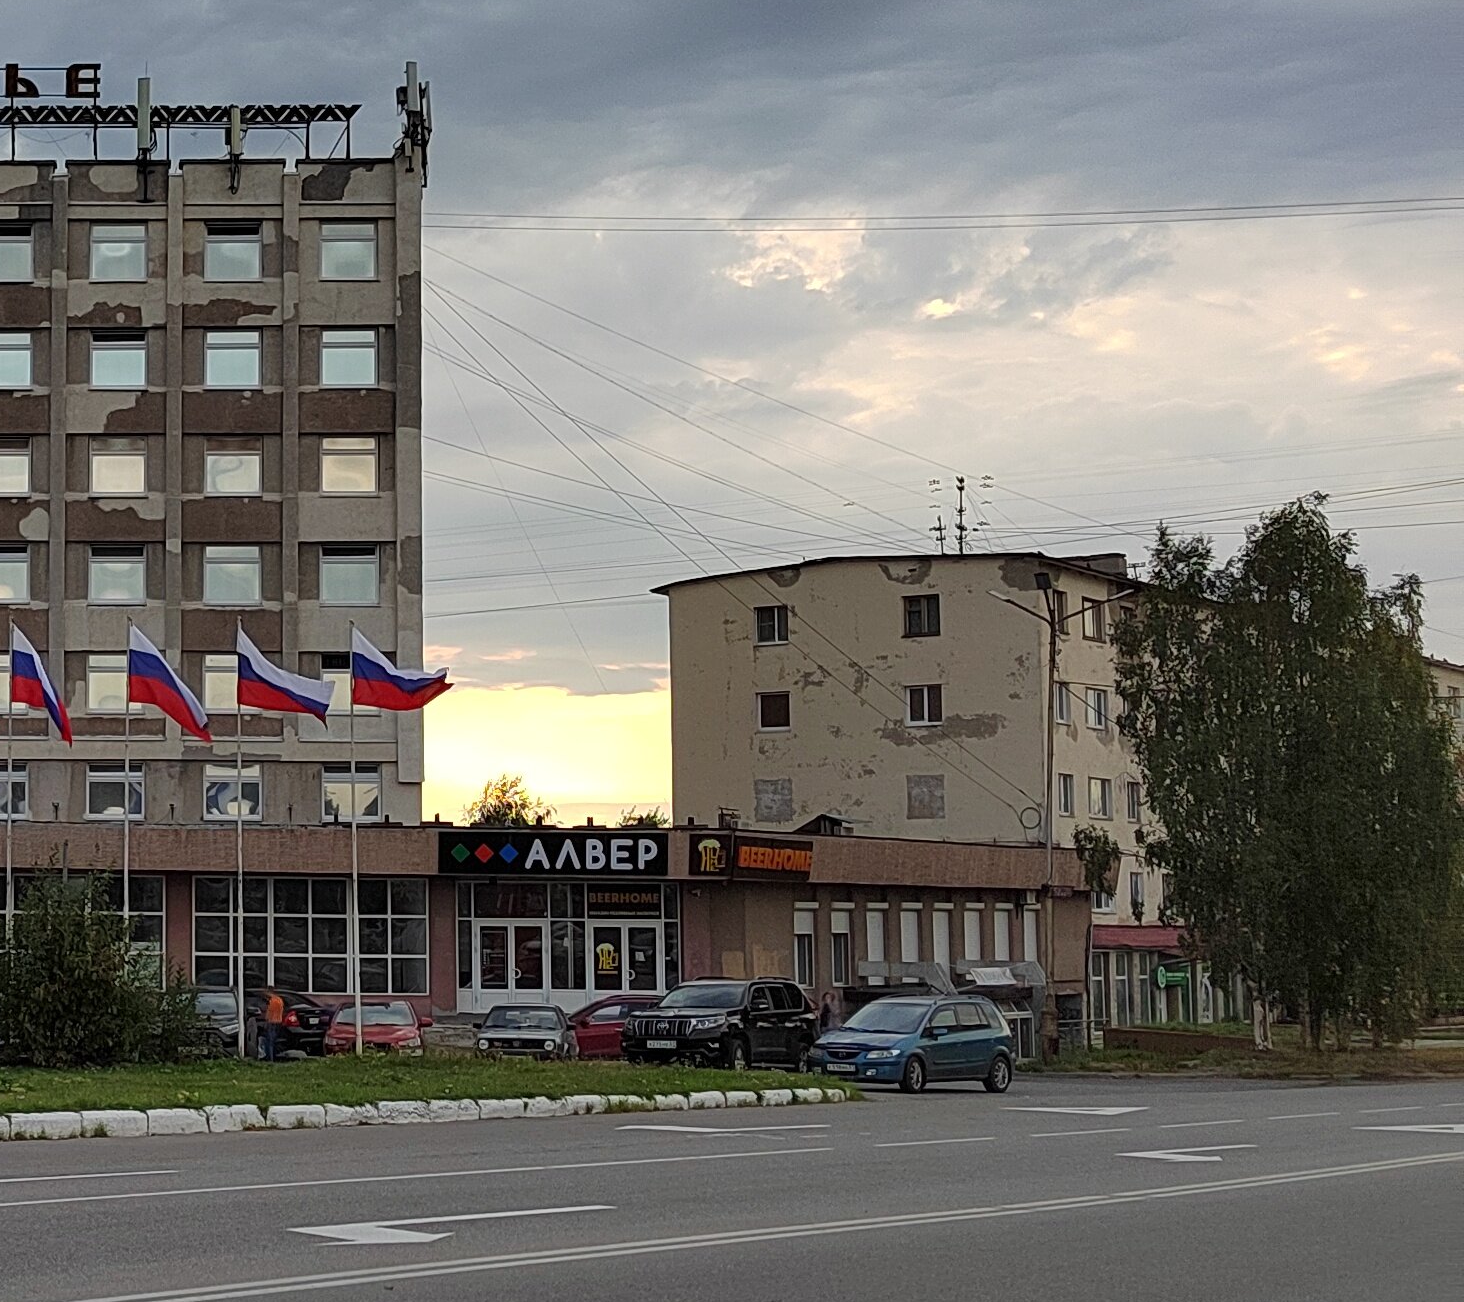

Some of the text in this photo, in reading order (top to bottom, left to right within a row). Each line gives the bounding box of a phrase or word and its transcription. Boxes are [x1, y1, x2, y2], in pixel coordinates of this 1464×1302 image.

[524, 838, 659, 870] АЛВЕР
[737, 844, 813, 872] BEERHOME
[589, 892, 660, 904] BEERHOME
